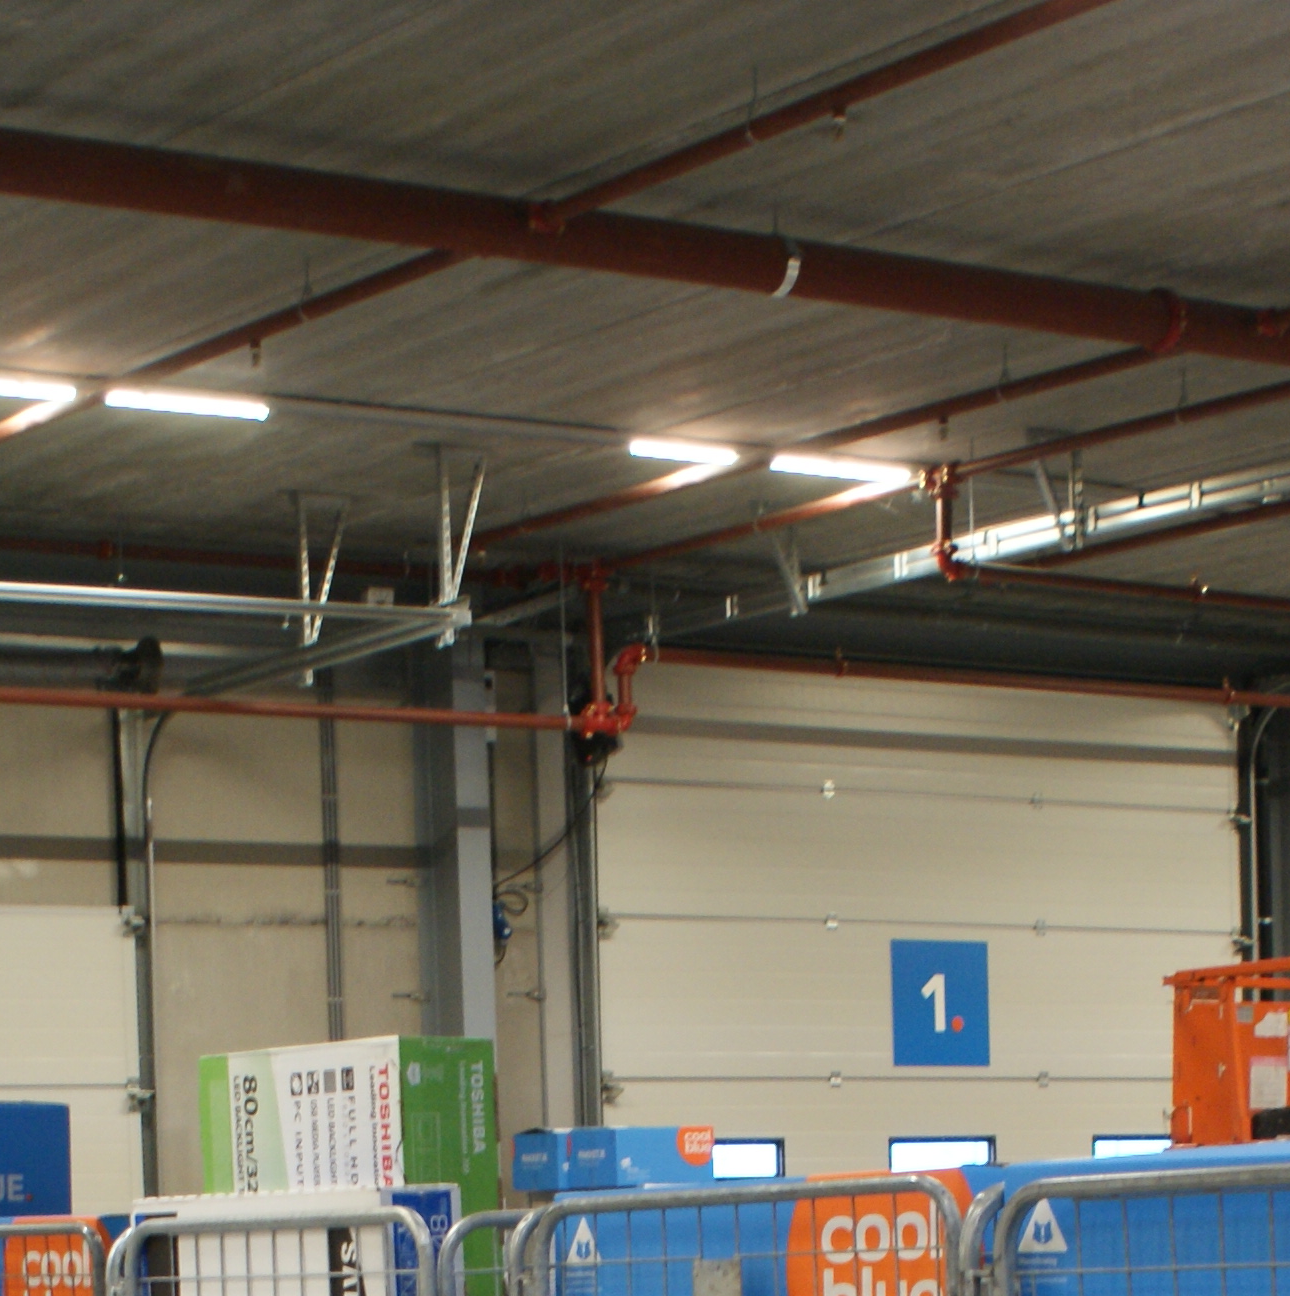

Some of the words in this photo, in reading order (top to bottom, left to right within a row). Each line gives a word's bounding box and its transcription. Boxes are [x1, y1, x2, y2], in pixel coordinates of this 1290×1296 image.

[233, 1075, 243, 1101] LED
[294, 1101, 303, 1123] PC
[326, 1098, 336, 1119] LED
[369, 1066, 380, 1119] Leading
[470, 1060, 486, 1153] TOSHIBA
[348, 1096, 358, 1147] FULL
[378, 1064, 394, 1187] TOSHIBA
[295, 1132, 305, 1185] INPUT
[349, 1156, 359, 1186] HD
[370, 1122, 381, 1191] Innovatio
[821, 1199, 942, 1264] cool
[23, 1243, 91, 1289] cool
